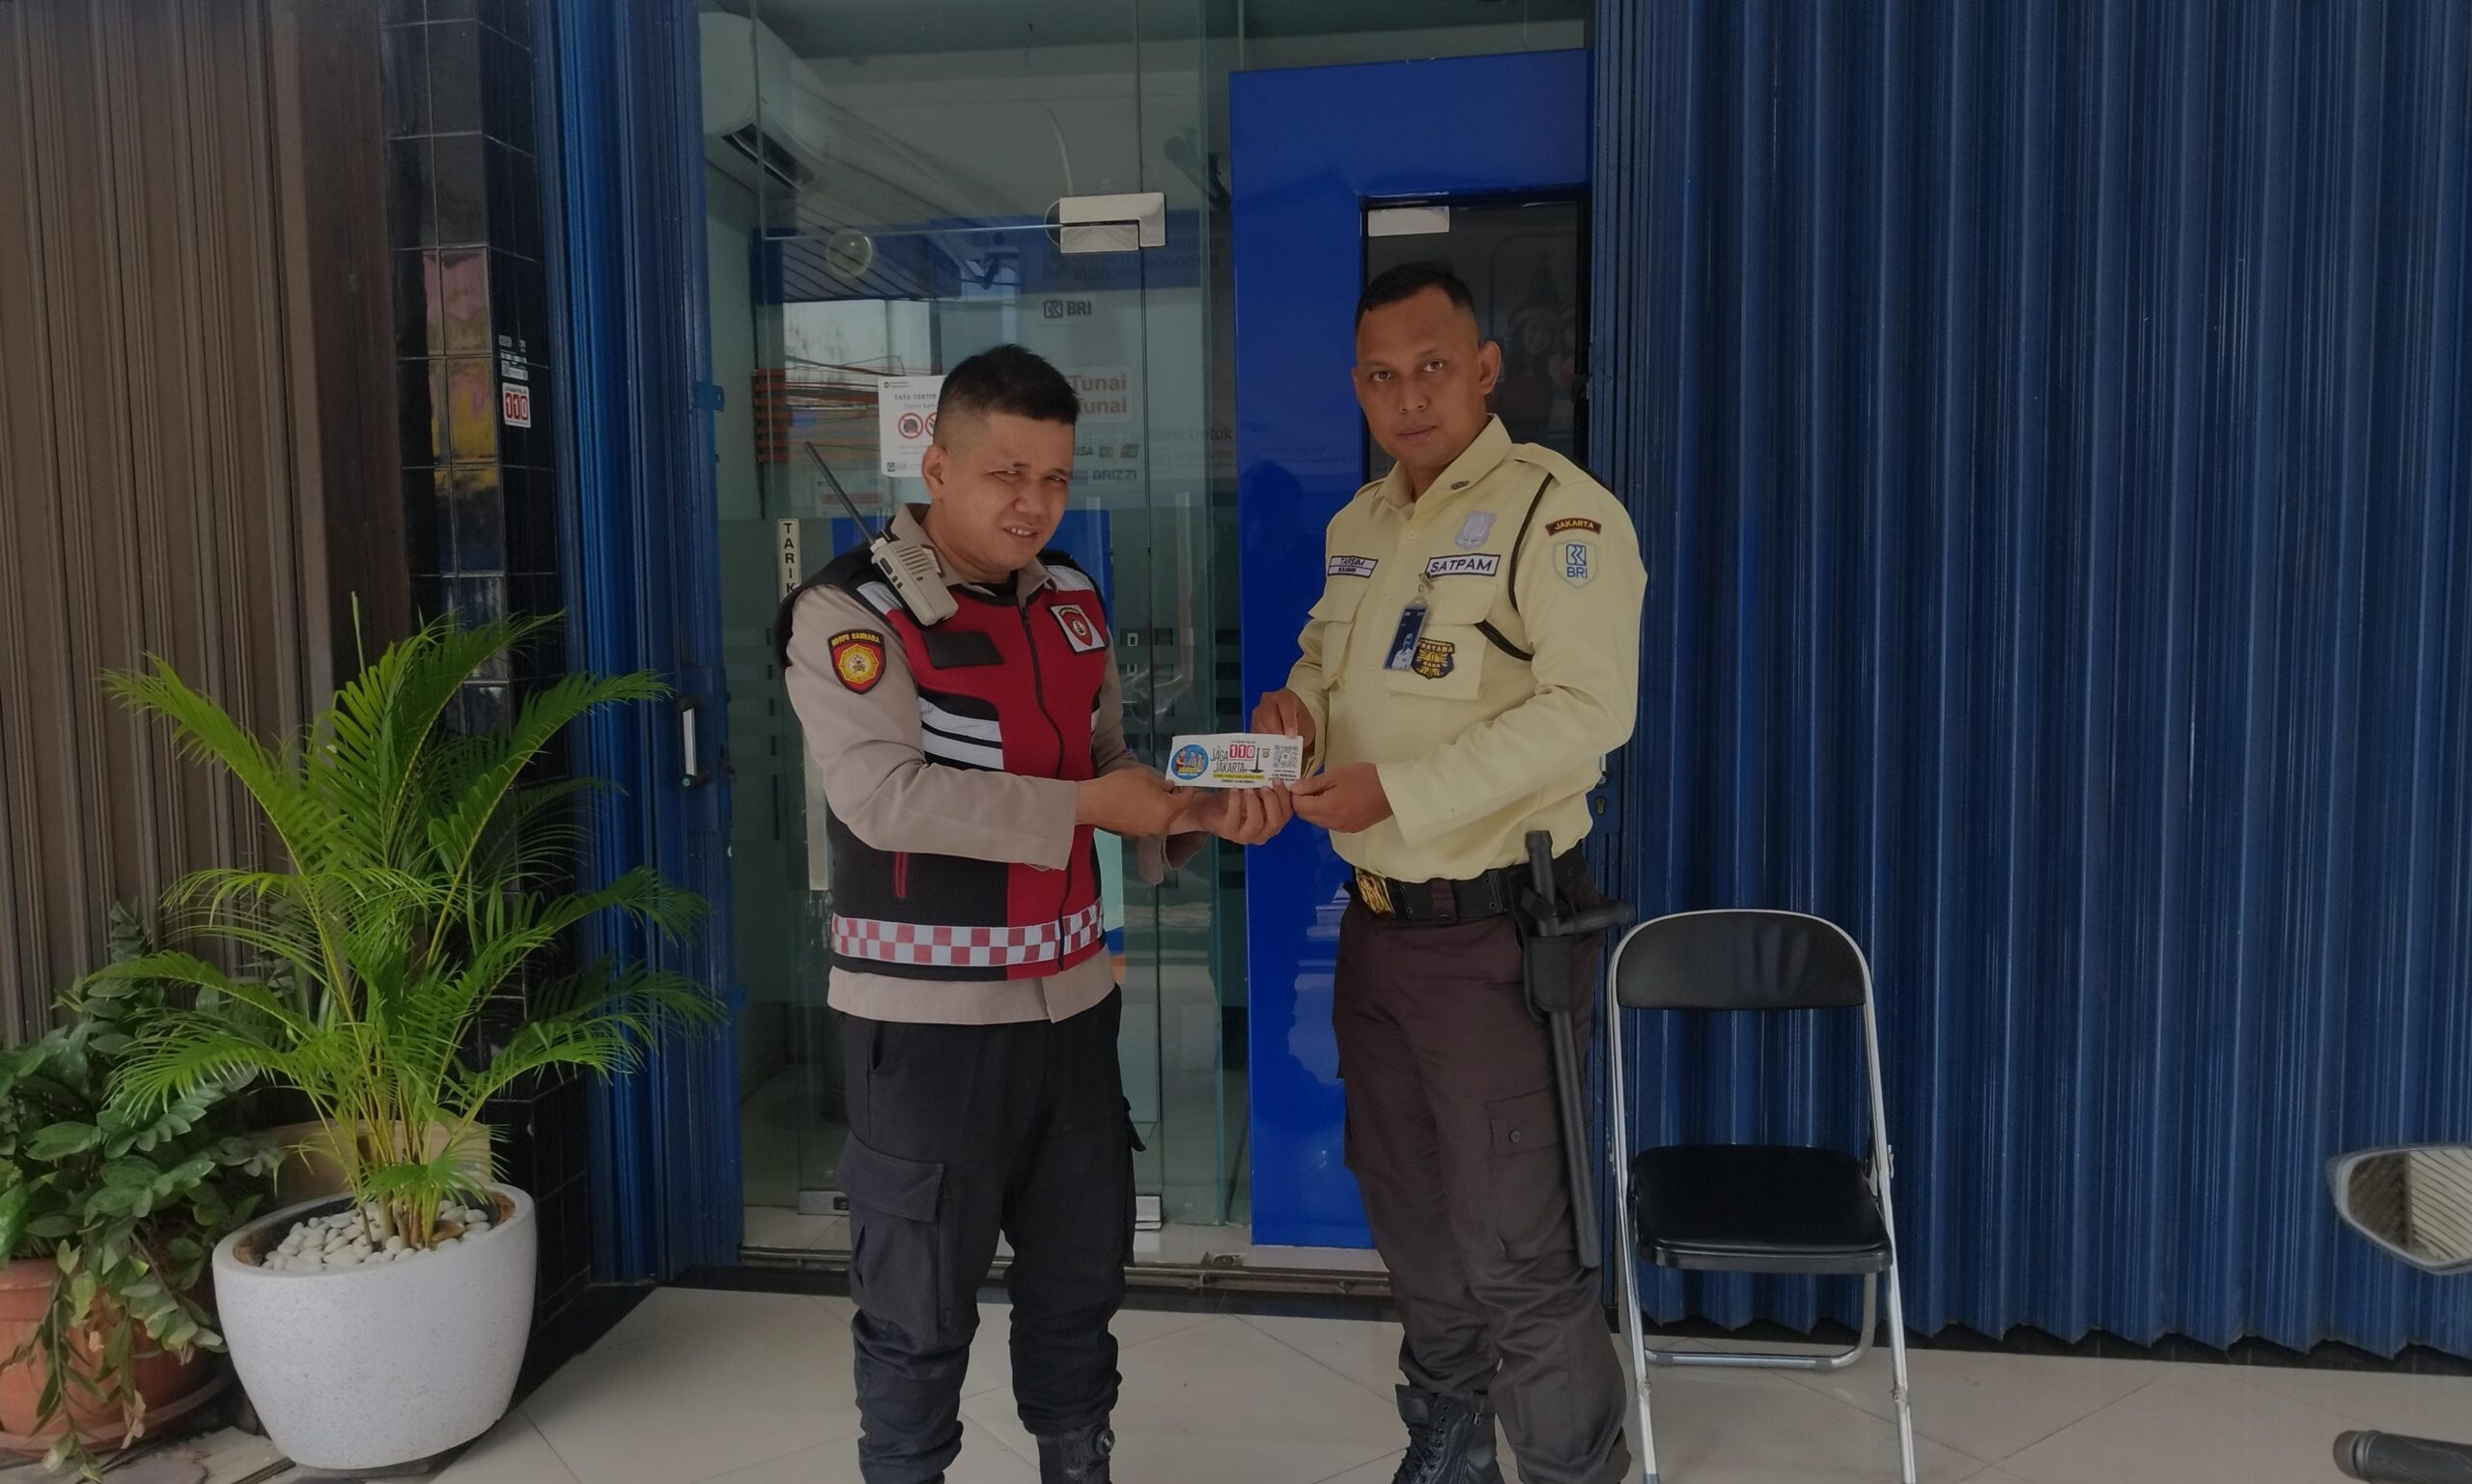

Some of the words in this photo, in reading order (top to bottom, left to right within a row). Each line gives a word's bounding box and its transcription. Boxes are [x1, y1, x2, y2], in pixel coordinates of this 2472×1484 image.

[1067, 301, 1092, 316] BRI
[1065, 373, 1128, 391] Tunai
[506, 393, 528, 420] 110
[1079, 396, 1128, 414] unai
[1555, 519, 1593, 530] JAKARTA
[783, 522, 796, 594] TARIK
[1430, 558, 1493, 574] SATPAM
[1566, 566, 1587, 578] BRI
[1210, 745, 1228, 762] JAGA
[1229, 744, 1255, 759] 110
[1213, 762, 1247, 773] JAKARTA
